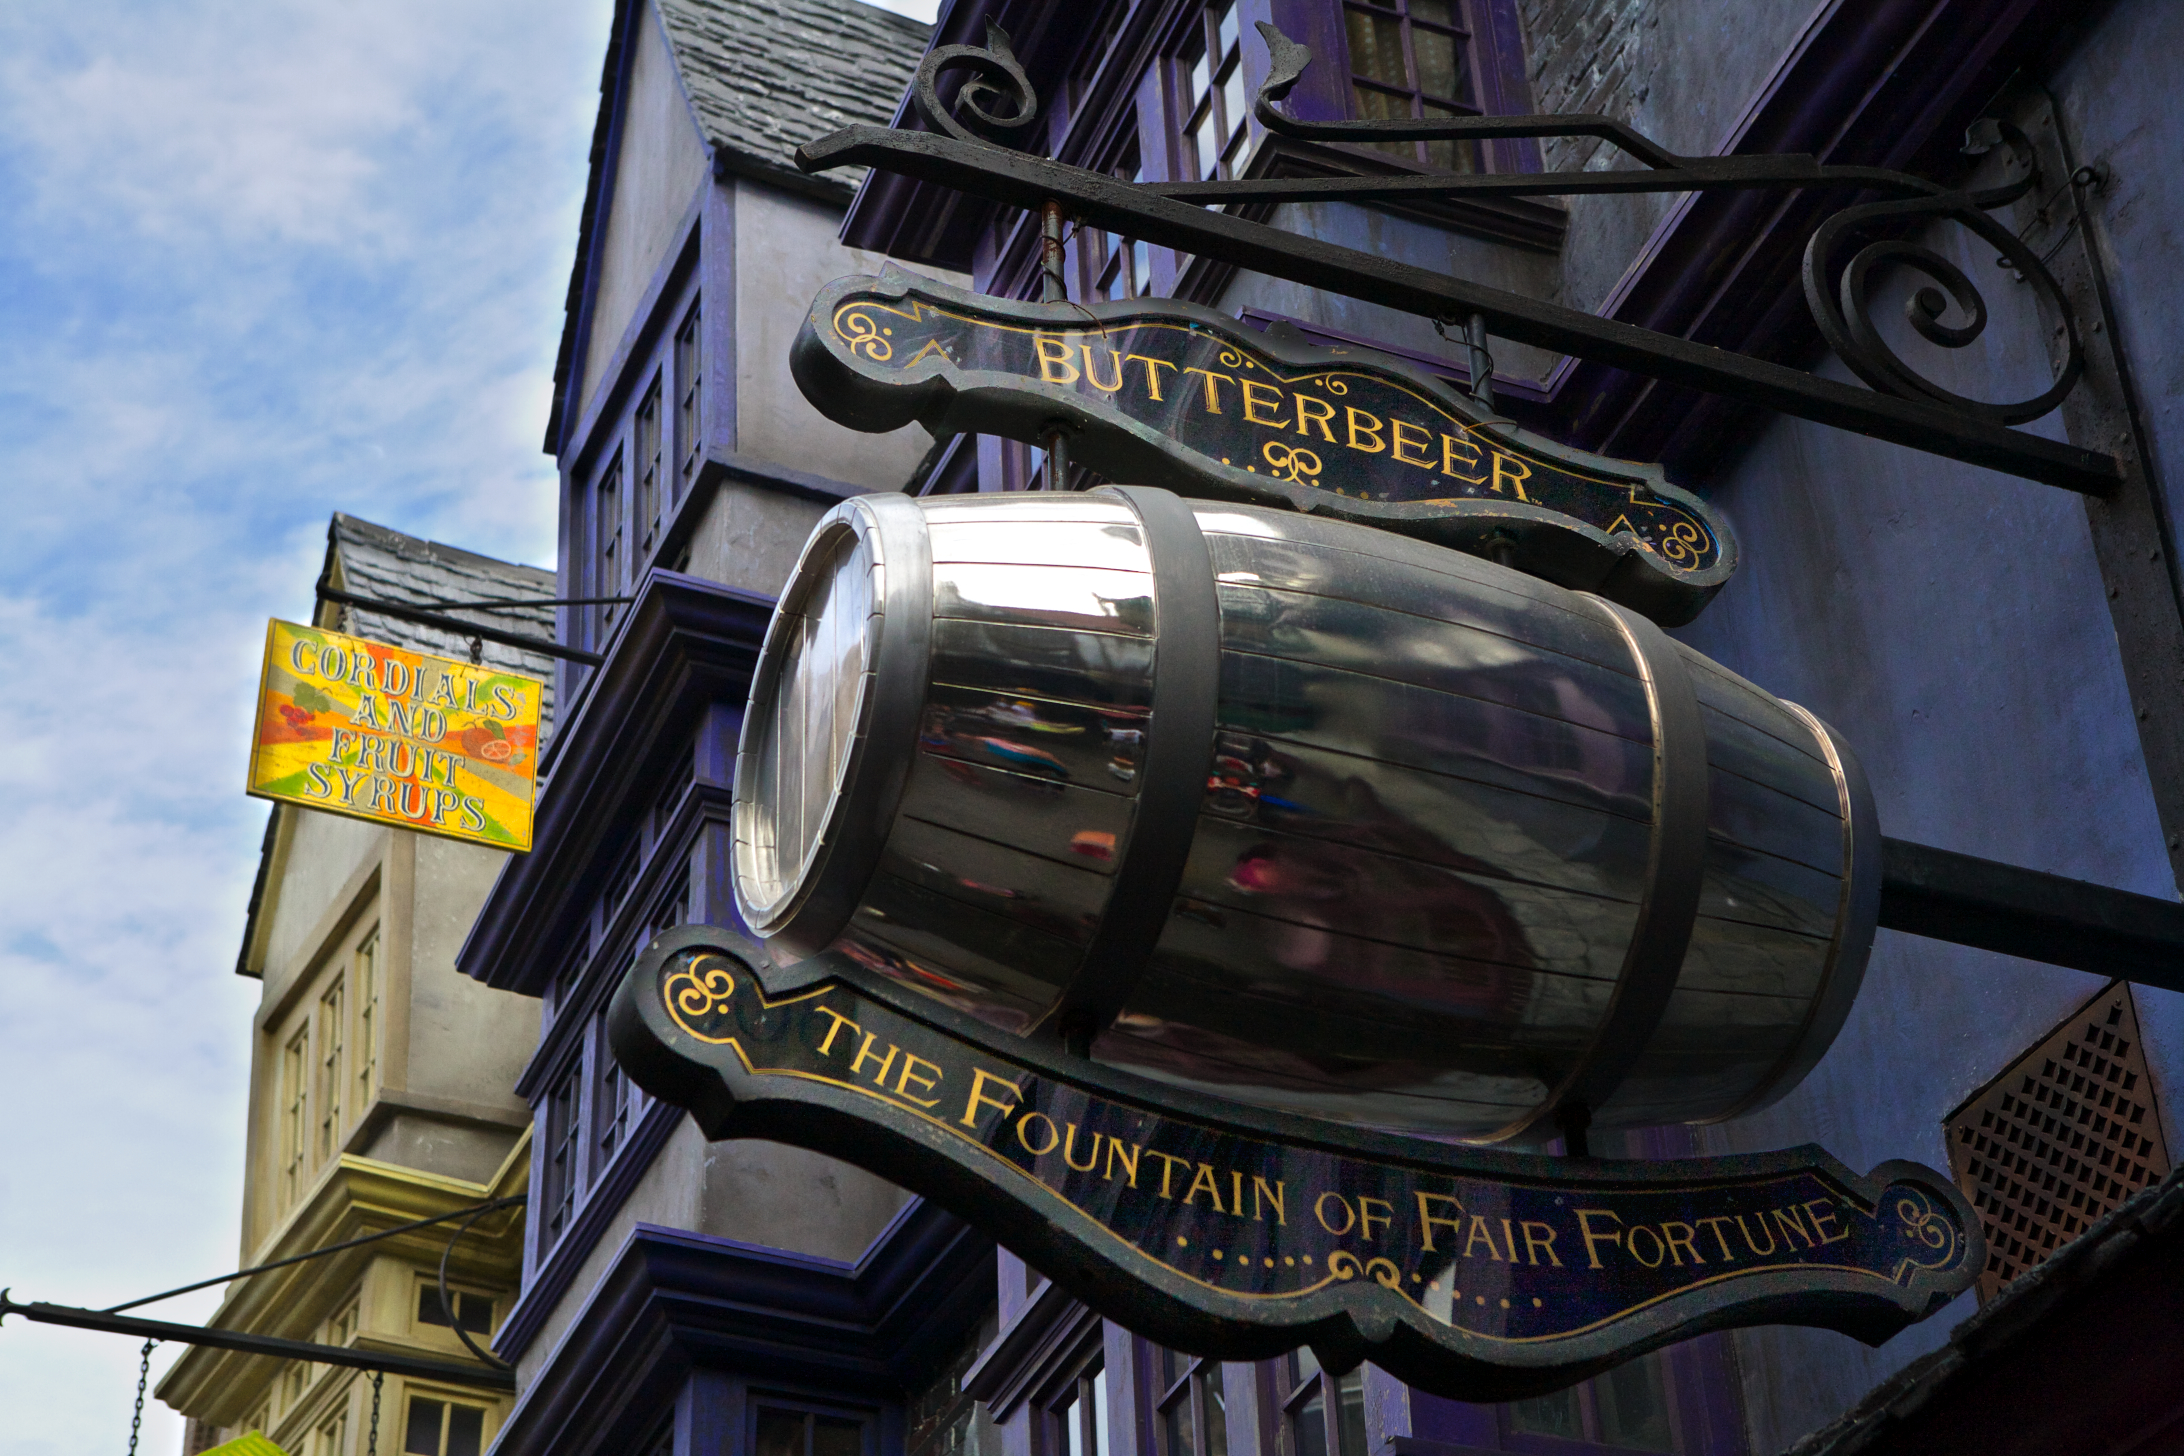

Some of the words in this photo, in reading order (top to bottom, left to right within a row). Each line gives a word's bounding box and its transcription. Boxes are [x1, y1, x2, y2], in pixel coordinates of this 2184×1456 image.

[1034, 336, 1535, 502] BUTTERBEER
[290, 639, 517, 721] CORDIALS
[349, 694, 447, 743] AND
[327, 726, 465, 788] FRUIT
[304, 761, 486, 832] SYRUPS
[814, 1005, 943, 1108] THE
[959, 1067, 1287, 1226] FOUNTAIN
[1314, 1191, 1394, 1241] OF
[1414, 1191, 1563, 1267] FAIR
[1572, 1197, 1850, 1269] FORTUNE
